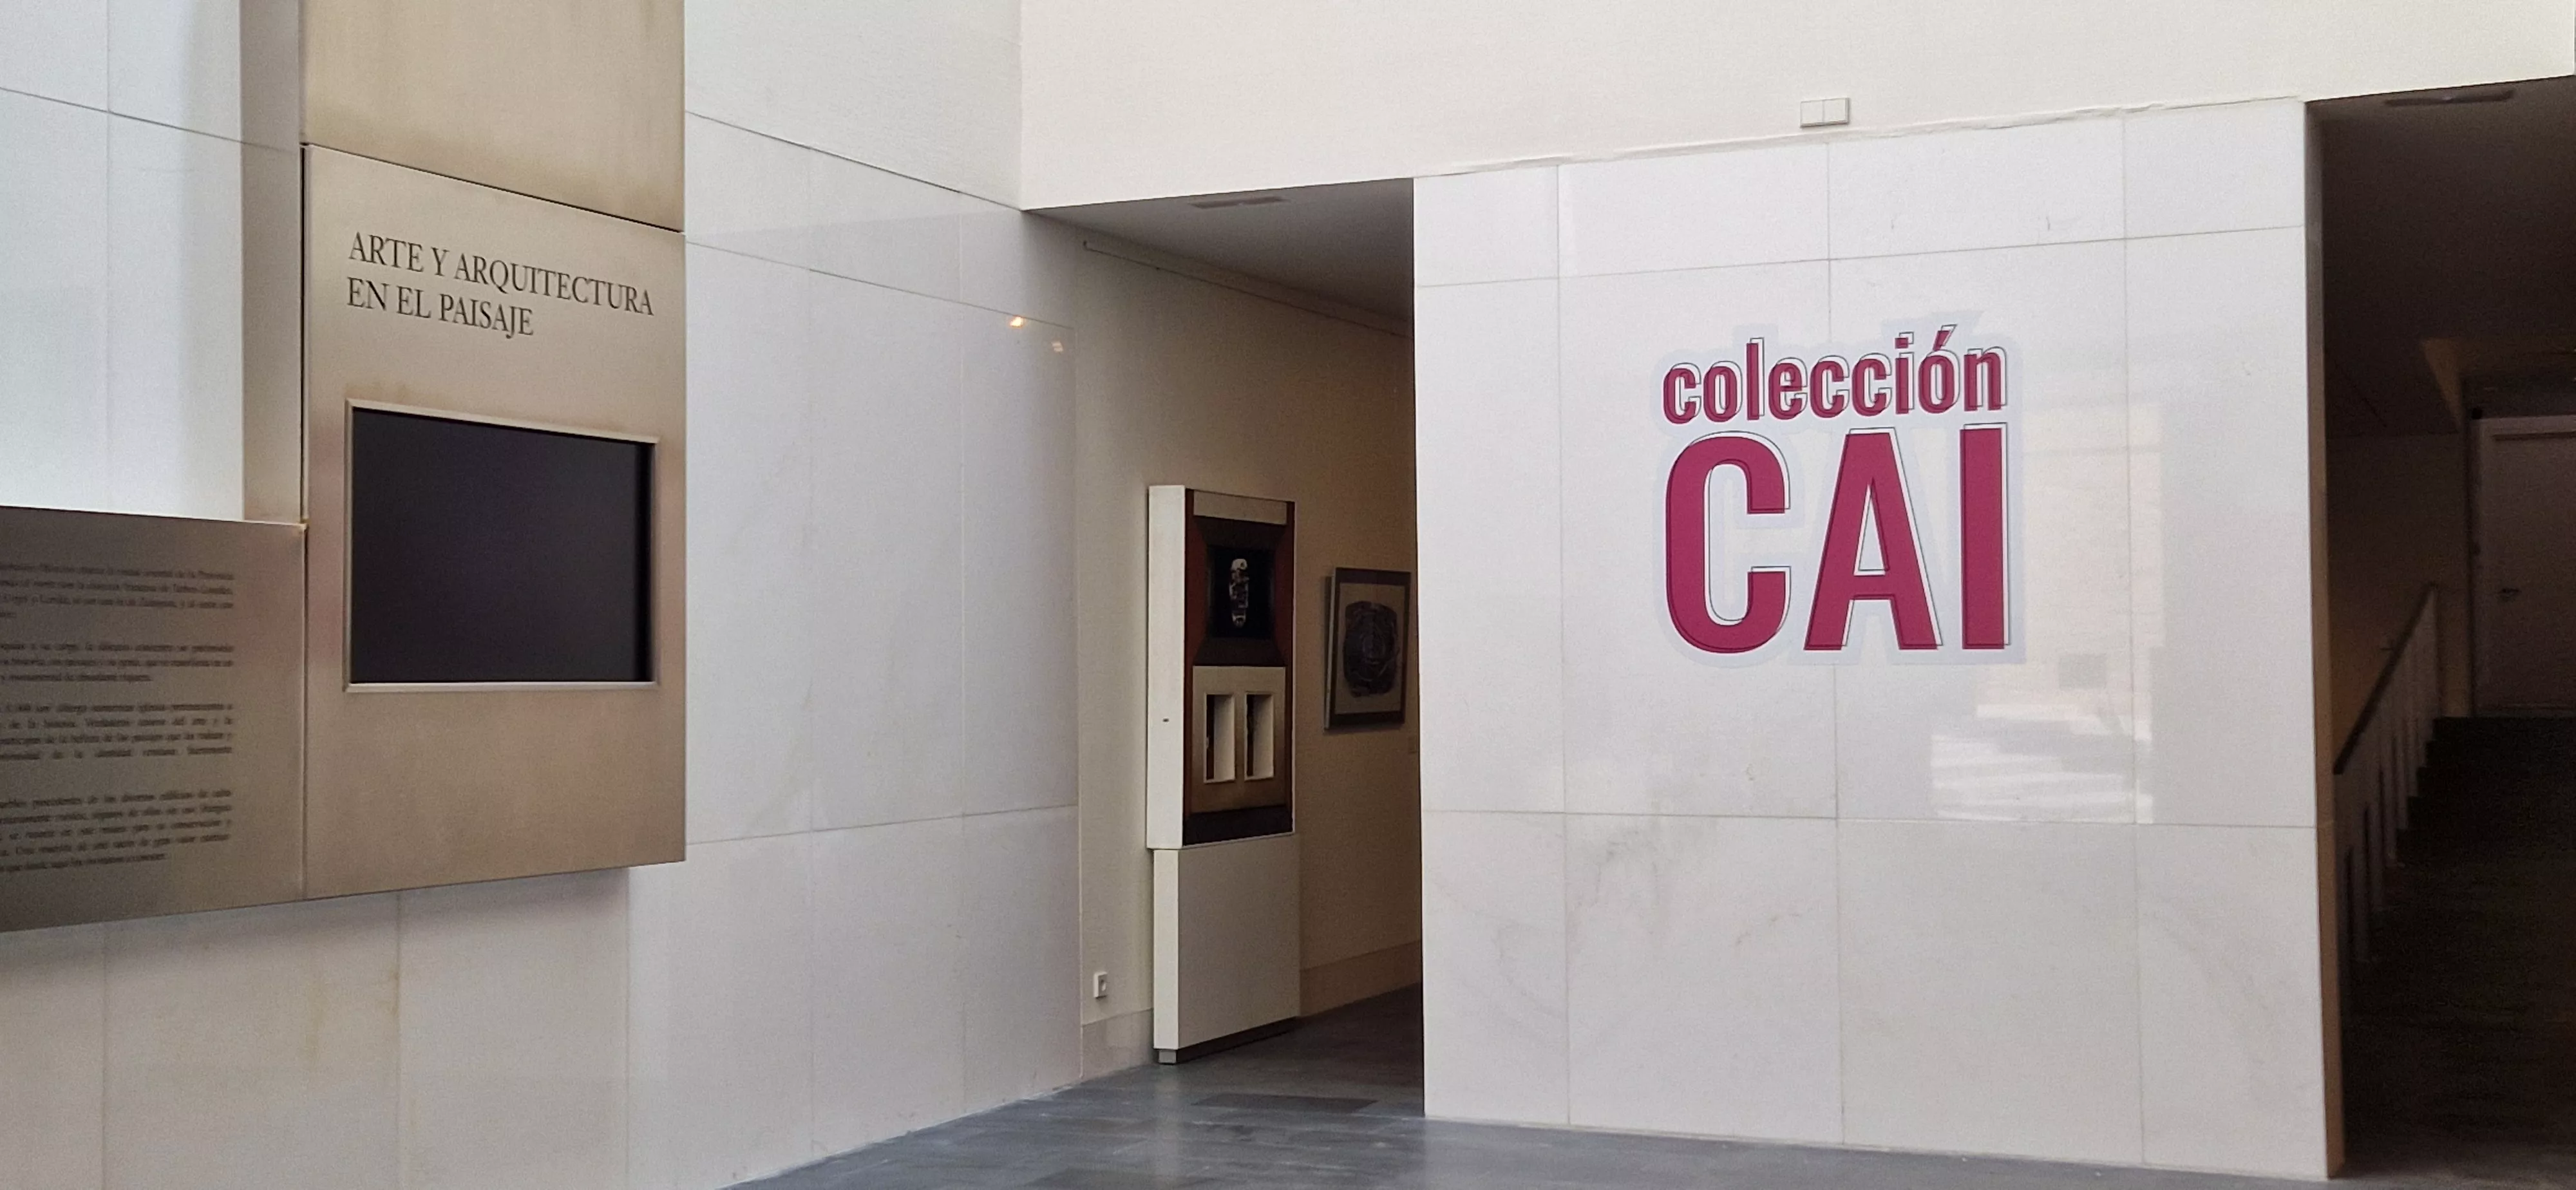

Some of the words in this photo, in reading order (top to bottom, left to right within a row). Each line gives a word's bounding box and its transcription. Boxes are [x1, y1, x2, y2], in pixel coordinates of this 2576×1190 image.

[347, 277, 388, 311] EN
[396, 285, 431, 319] EL
[439, 294, 534, 339] PAISAJE
[348, 232, 424, 272] ARTE
[430, 247, 449, 276] Y
[454, 254, 654, 316] ARQUITECTURA
[1663, 324, 2007, 424] colección
[1665, 422, 2011, 654] CAI
